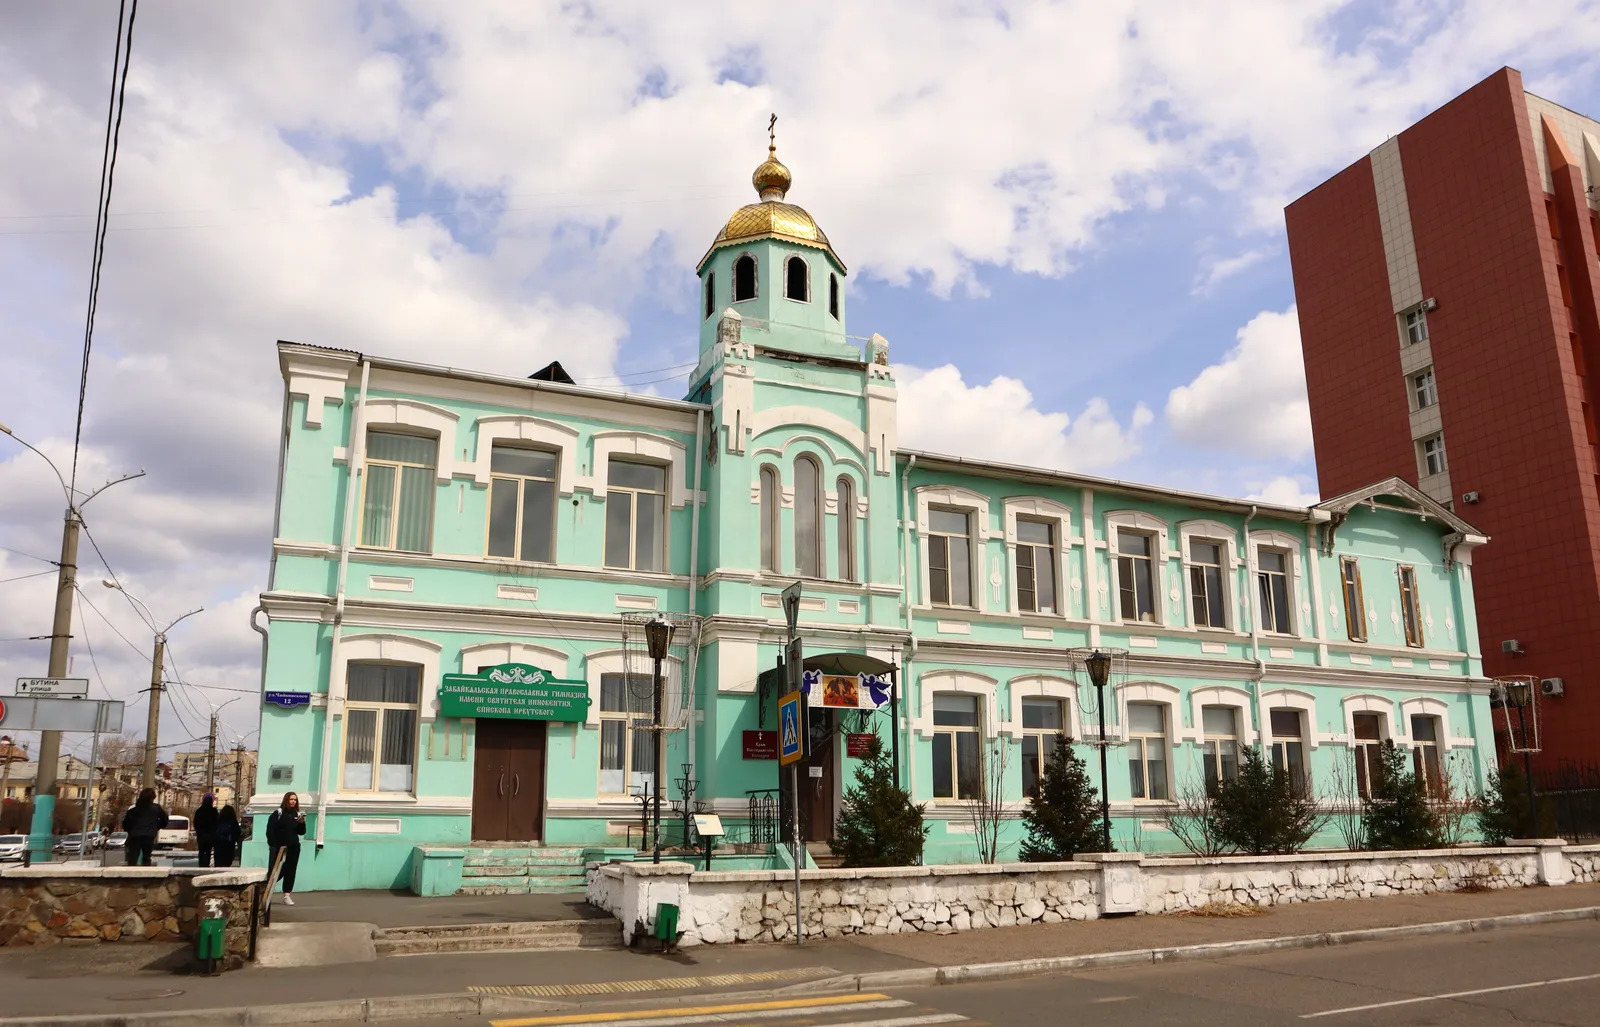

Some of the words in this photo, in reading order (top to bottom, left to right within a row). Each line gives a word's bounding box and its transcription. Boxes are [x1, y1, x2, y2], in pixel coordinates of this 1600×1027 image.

[444, 685, 498, 694] ЗАБАЙКАЛЬСКАЯ
[500, 688, 548, 697] ПРАВОСЛАВНАЯ
[552, 691, 586, 699] ГИМНАЗИЯ
[487, 697, 526, 705] СВЯТИТЕЛЯ
[514, 708, 554, 716] ИРКУТСКОГО
